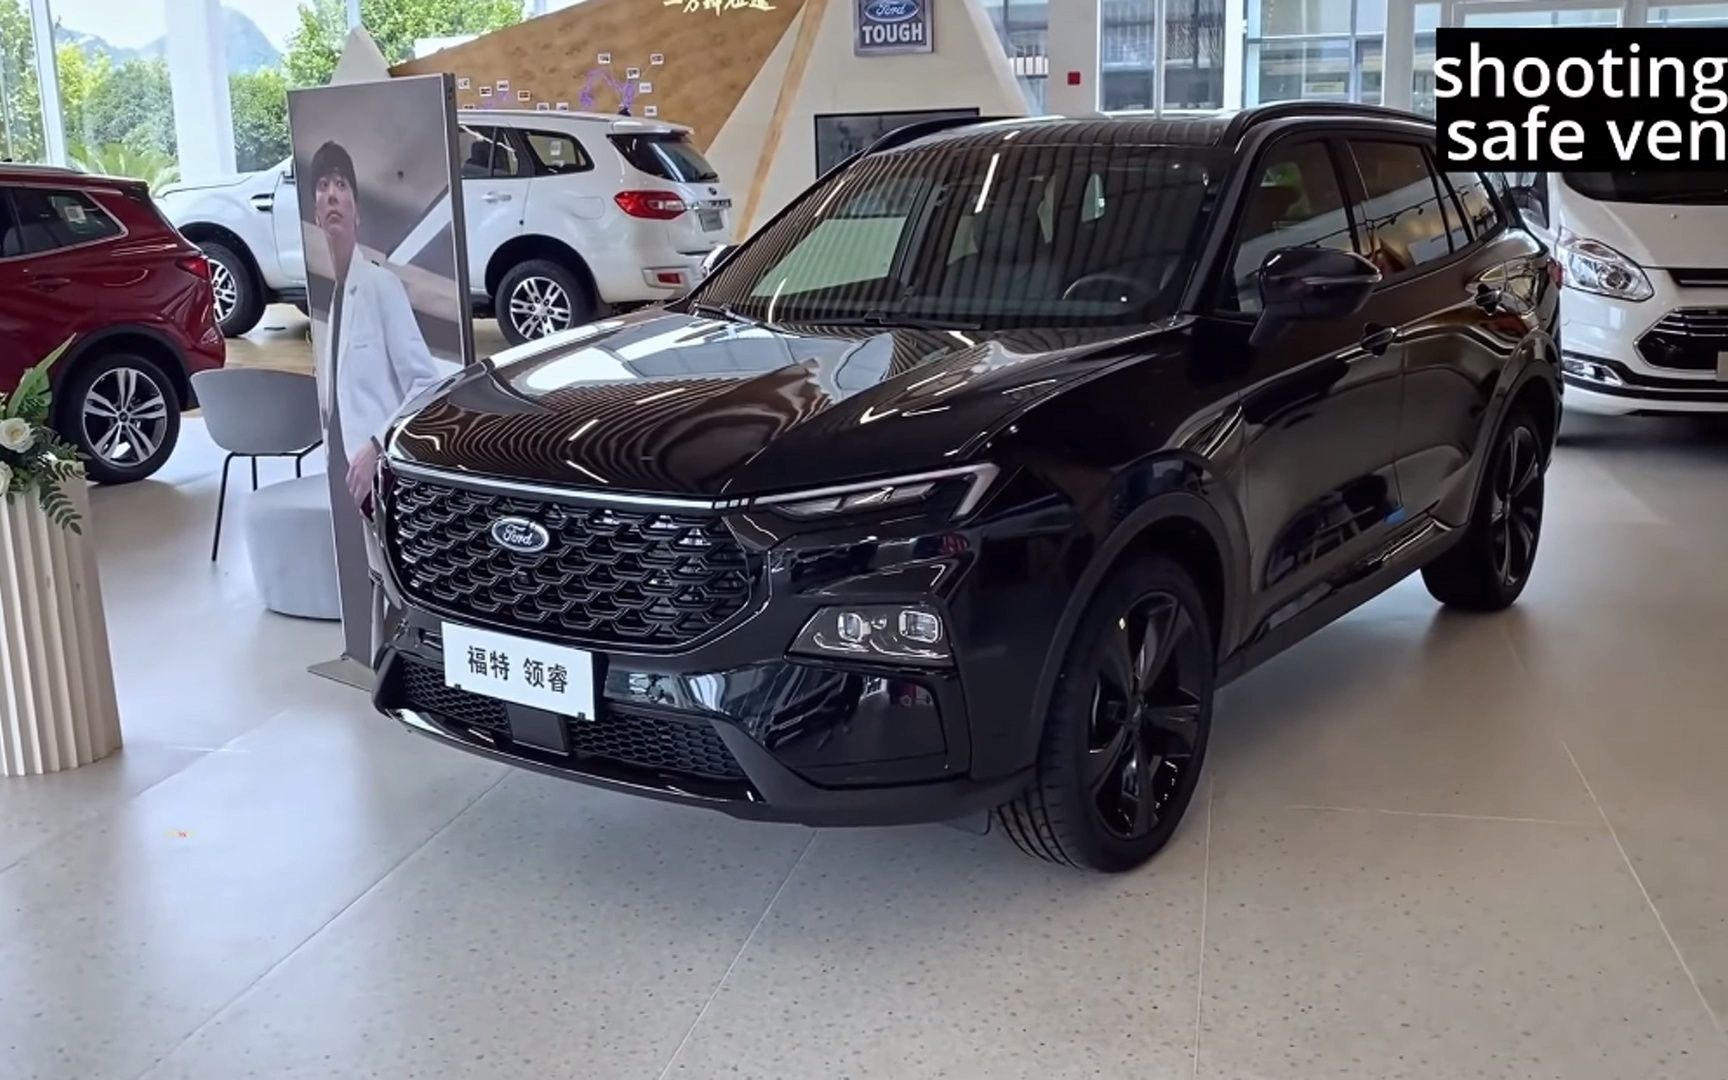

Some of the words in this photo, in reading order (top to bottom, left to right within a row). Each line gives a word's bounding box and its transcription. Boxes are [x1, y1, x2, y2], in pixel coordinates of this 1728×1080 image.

[875, 1, 907, 16] Ford
[862, 22, 923, 44] TOUGH
[503, 524, 533, 545] Ford
[467, 645, 510, 681] 福特
[523, 657, 568, 694] 领睿
